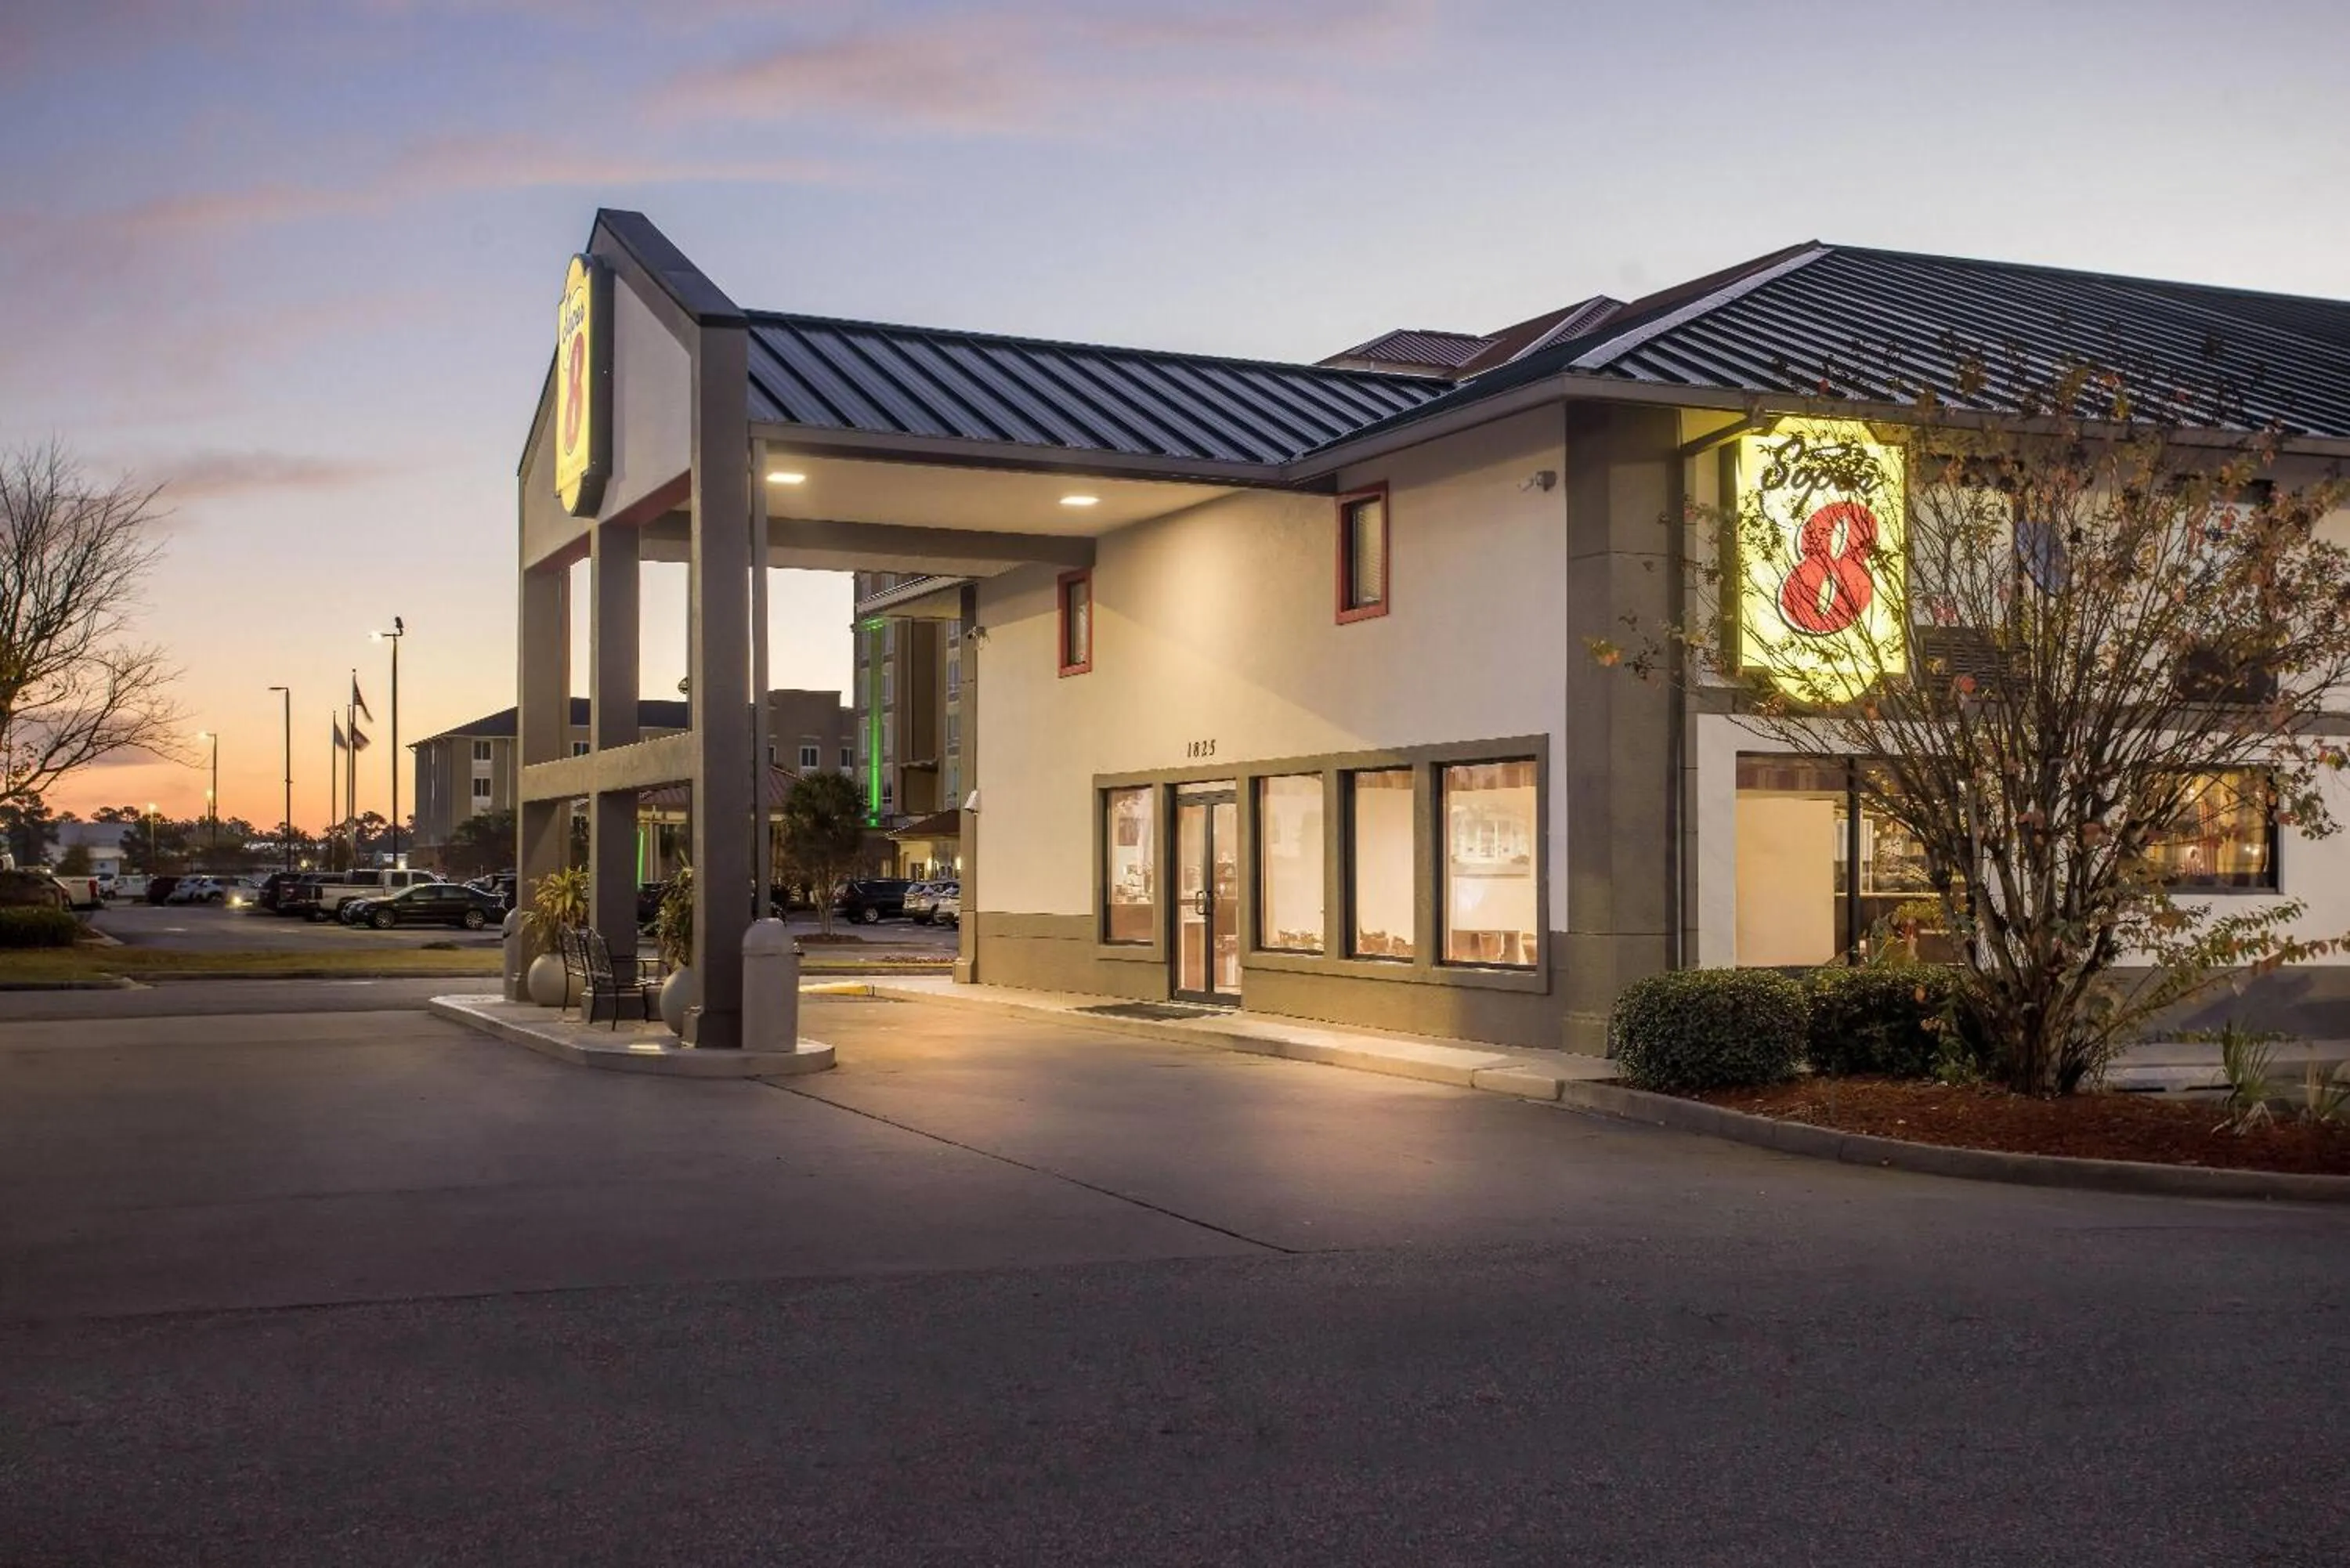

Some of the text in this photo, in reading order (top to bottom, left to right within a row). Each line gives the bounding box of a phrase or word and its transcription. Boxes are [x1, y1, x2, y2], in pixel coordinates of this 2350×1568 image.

[565, 331, 584, 455] 8
[1777, 501, 1878, 637] 8
[1187, 739, 1216, 758] 1825
